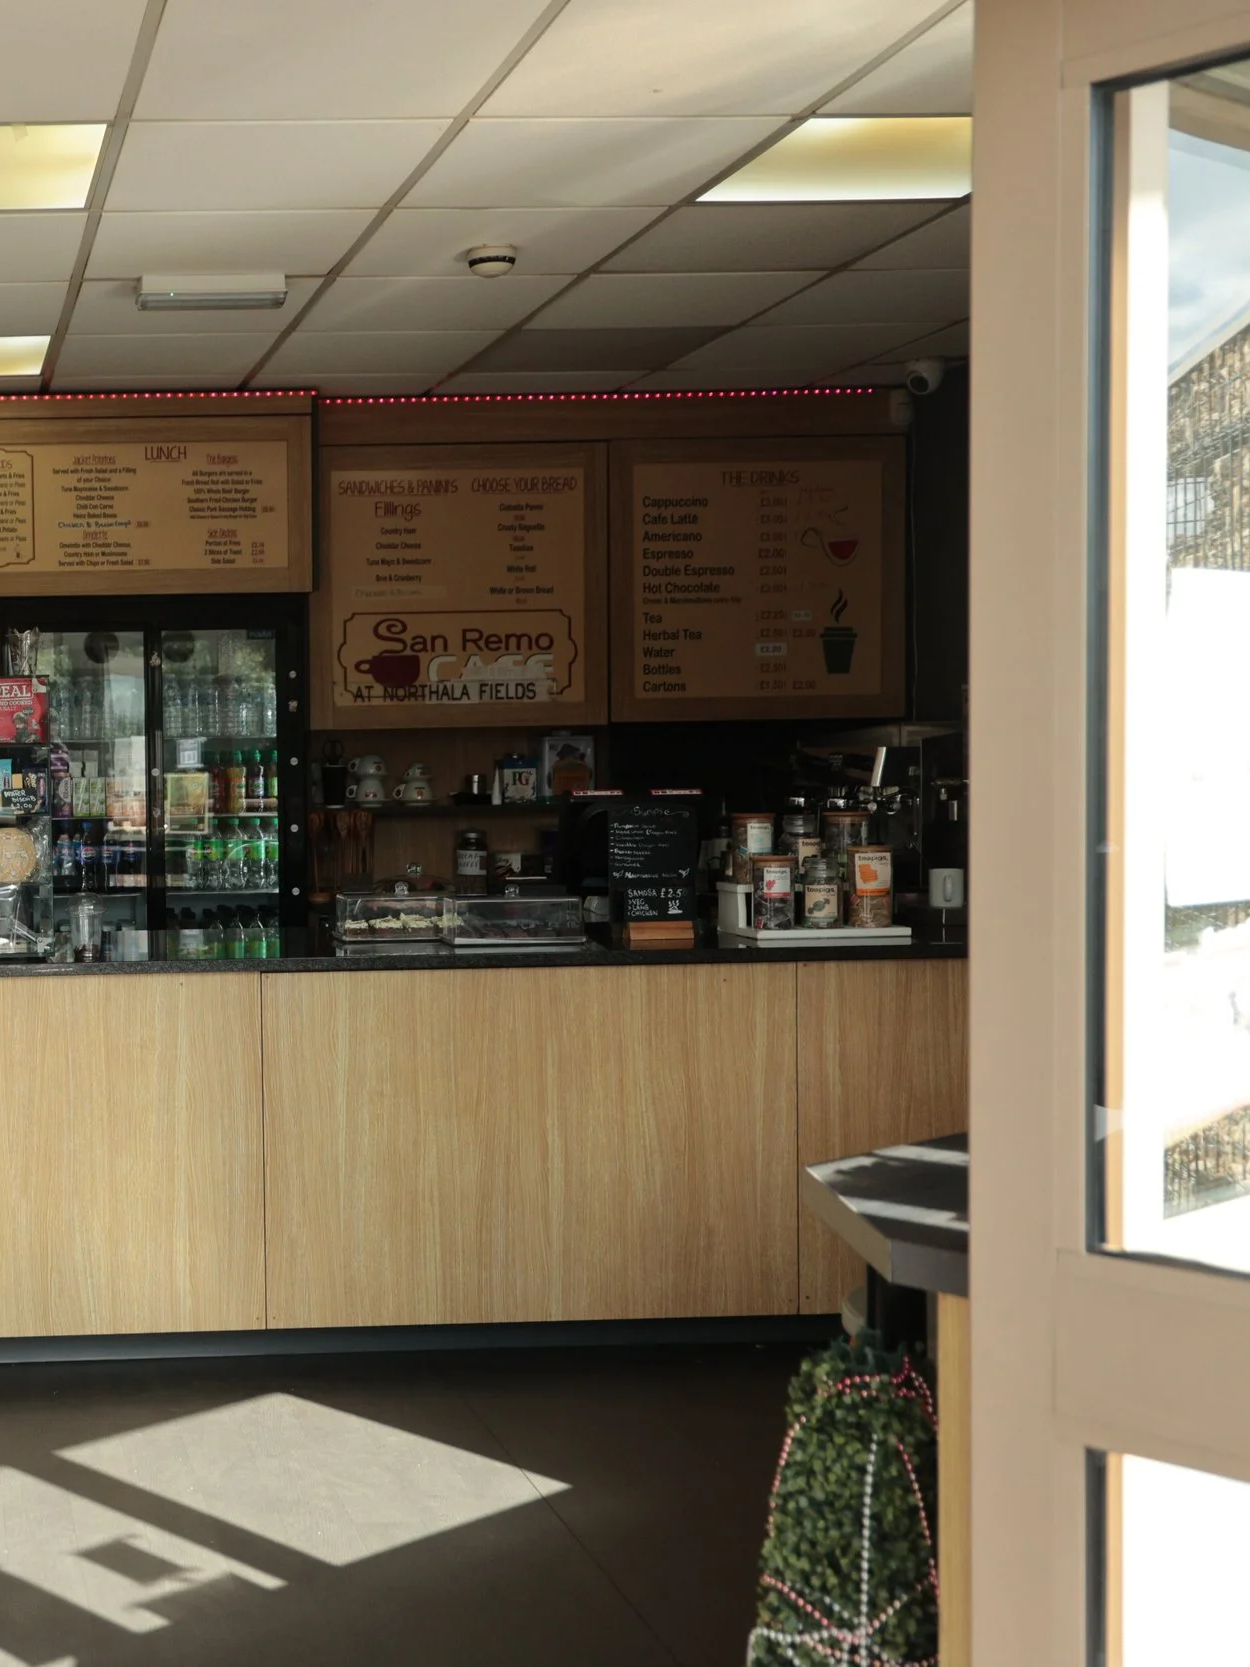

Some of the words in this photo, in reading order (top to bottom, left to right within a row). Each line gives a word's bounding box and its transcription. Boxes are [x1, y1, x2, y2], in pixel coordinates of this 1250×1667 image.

[144, 446, 188, 461] LUNCH
[721, 471, 747, 486] THE
[750, 470, 801, 485] DRINKS
[337, 479, 405, 496] SANDWICHES
[406, 480, 415, 494] &
[471, 478, 512, 493] CHOOSE
[513, 478, 540, 492] YOUR
[540, 477, 578, 492] BREAD
[642, 496, 709, 510] Cappuccino
[374, 500, 422, 522] Fillings
[642, 513, 668, 525] Cafe
[380, 527, 402, 536] Country
[403, 527, 416, 535] Ham
[642, 531, 703, 542] Americano
[375, 542, 399, 550] Cheddar
[400, 542, 421, 550] Cheese
[642, 548, 694, 562] Espresso
[506, 565, 524, 573] White
[524, 565, 537, 573] Roll
[642, 565, 682, 577] Double
[684, 565, 735, 577] Espresso
[642, 582, 662, 594] Hot
[665, 581, 721, 594] Chocolate
[643, 612, 664, 624] Tea
[372, 618, 449, 657] San
[461, 628, 555, 653] Remo
[642, 629, 680, 642] Herbal
[682, 629, 704, 642] Tea
[642, 645, 675, 658] Water
[642, 663, 683, 676] Bottles
[354, 686, 377, 703] AT
[383, 683, 471, 703] NORTHALA
[479, 682, 538, 701] FIELDS
[642, 680, 688, 693] Cartons
[8, 699, 33, 707] COOKED
[628, 888, 658, 898] SAMOSA
